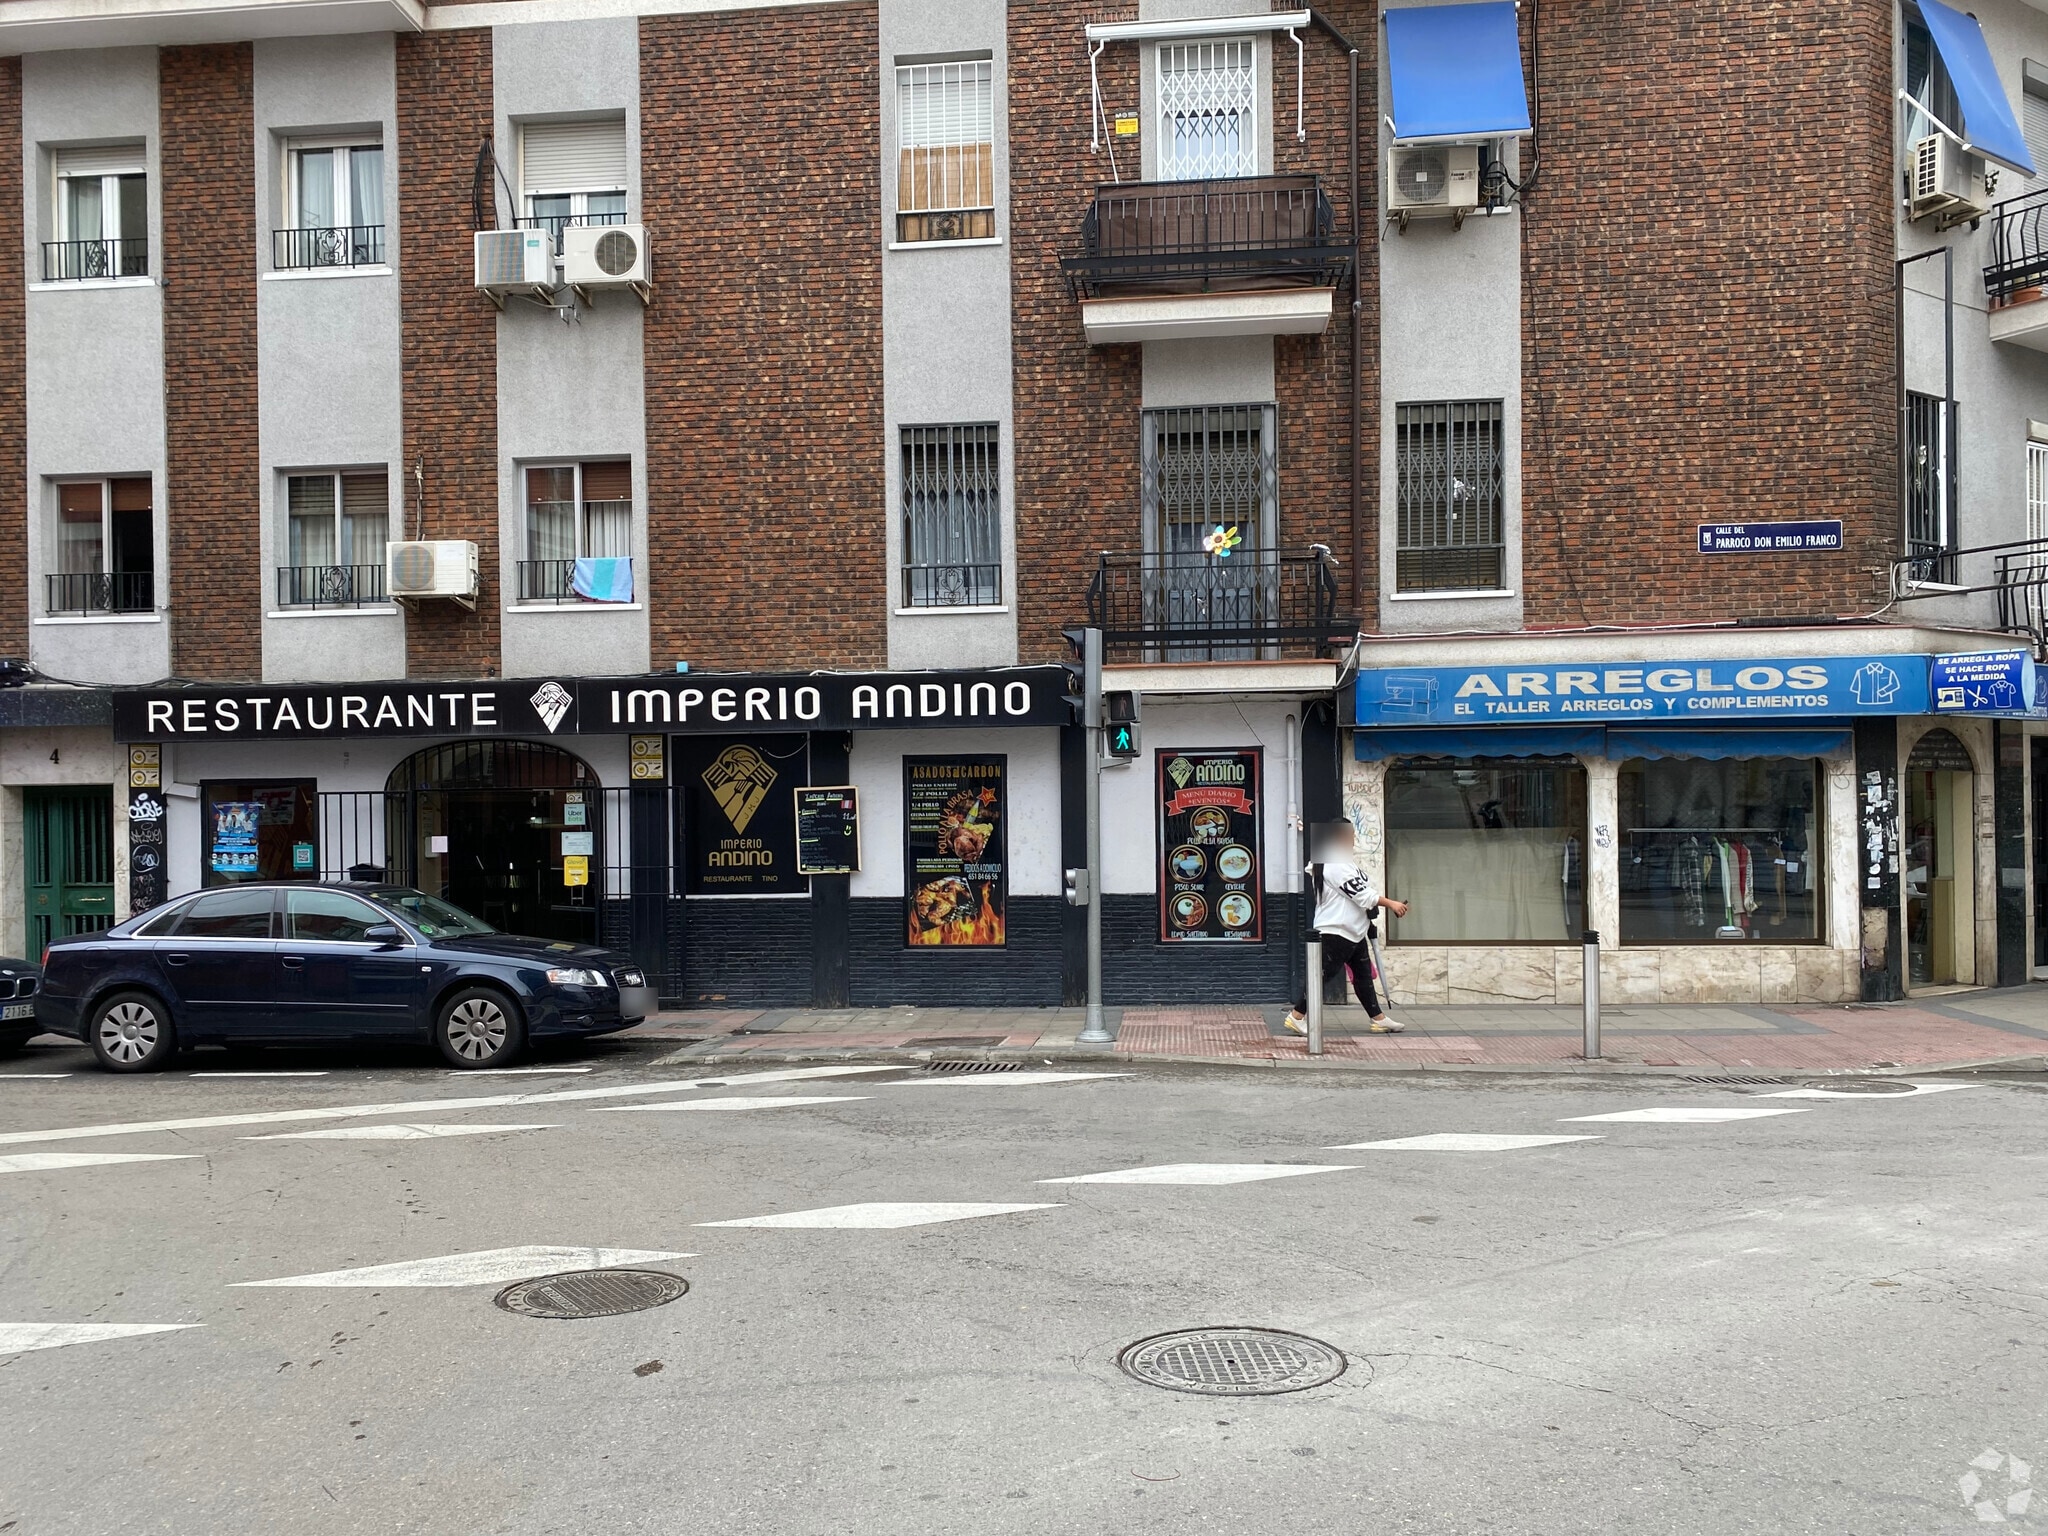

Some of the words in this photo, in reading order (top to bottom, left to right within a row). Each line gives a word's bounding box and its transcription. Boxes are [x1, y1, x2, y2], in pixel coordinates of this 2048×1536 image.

[1716, 526, 1732, 534] CALLE
[1734, 526, 1745, 534] DEL
[1716, 538, 1750, 548] PARROCO
[1754, 536, 1772, 548] DON
[1776, 536, 1802, 547] EMILIO
[1806, 534, 1837, 546] FRANCO
[1950, 655, 1994, 664] ARREGLA
[1995, 653, 2020, 661] ROPA
[1958, 665, 1984, 673] HACE
[1986, 663, 2010, 672] ROPA
[1453, 665, 1830, 699] ARREGLOS
[1970, 673, 2006, 682] MEDIDA
[610, 685, 822, 724] IMPERIO
[852, 680, 1032, 720] ANDINO
[1454, 702, 1478, 716] EL
[1484, 700, 1551, 715] TALLER
[1560, 698, 1655, 713] ARREGLOS
[1664, 697, 1676, 710] Y
[1686, 694, 1829, 711] COMPLEMENTOS
[147, 692, 498, 734] RESTAURANTE
[49, 748, 60, 764] 4
[912, 766, 951, 778] ASADOS
[960, 765, 1001, 778] CARBON
[1196, 764, 1245, 782] ANDINO
[1208, 790, 1236, 798] DIARIO
[938, 828, 948, 855] POLLO
[947, 789, 974, 808] BRASA
[720, 838, 762, 850] IMPERIO
[708, 850, 773, 866] ANDINO
[4, 1006, 27, 1018] 2116
